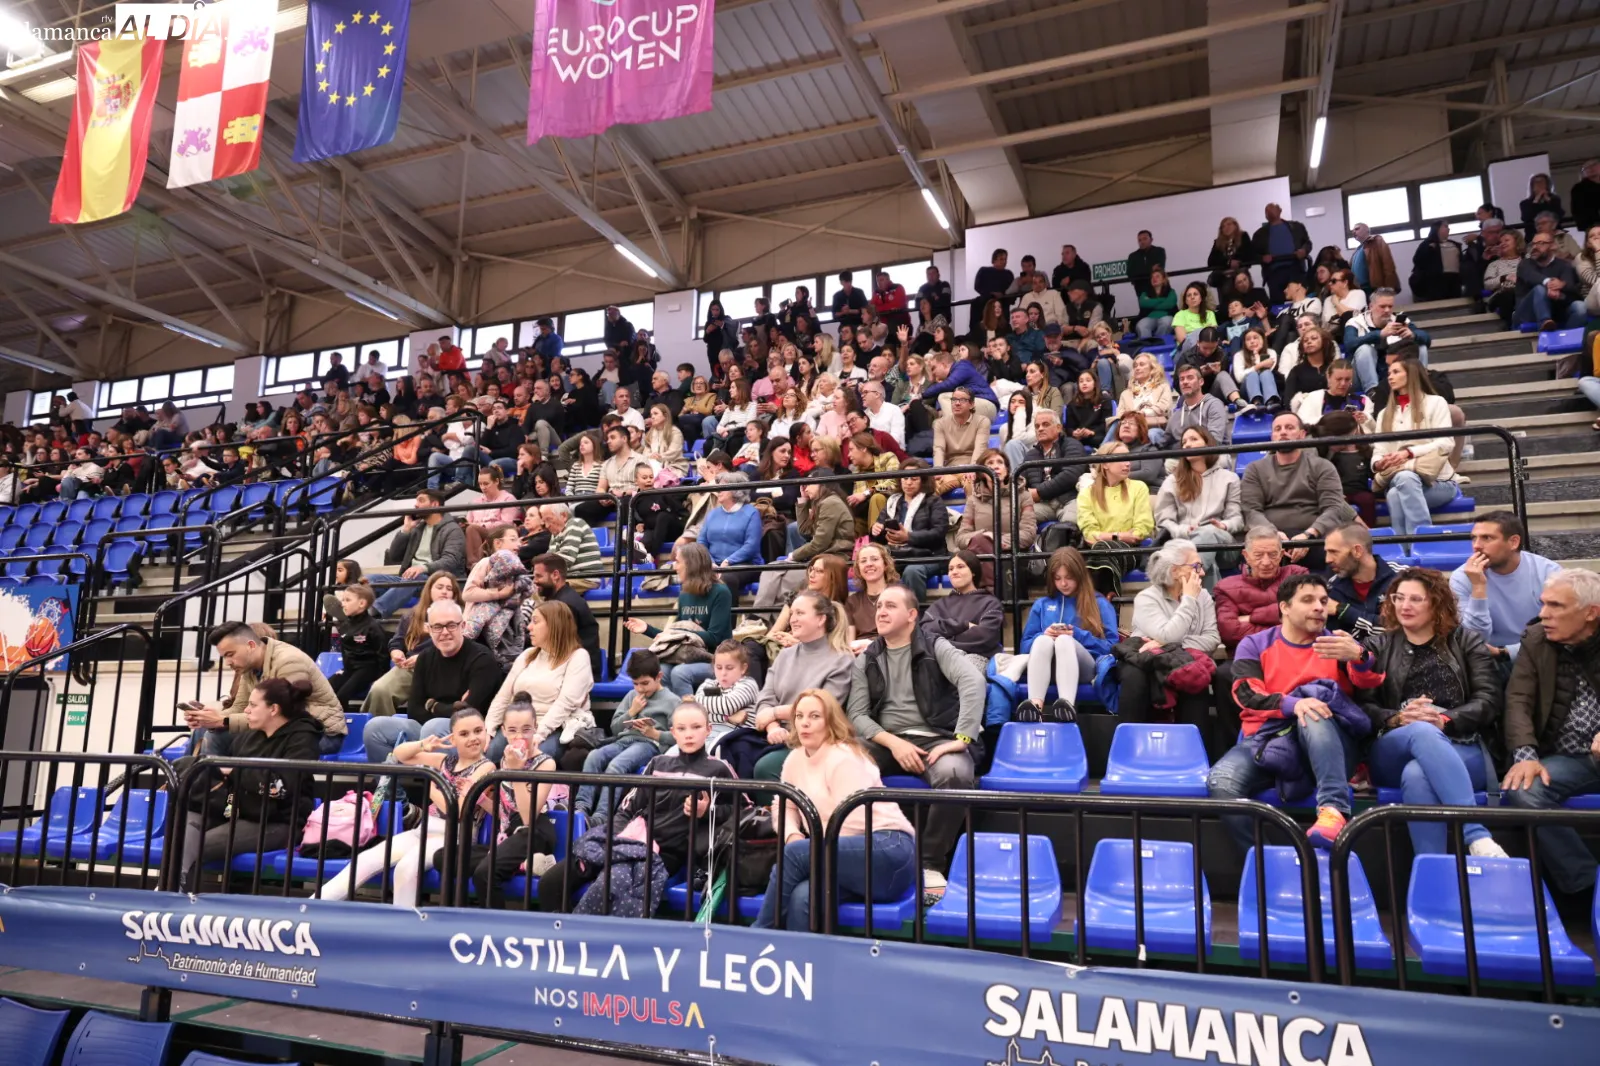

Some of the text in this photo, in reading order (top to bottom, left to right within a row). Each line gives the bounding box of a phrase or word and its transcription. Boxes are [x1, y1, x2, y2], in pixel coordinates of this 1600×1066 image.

[547, 4, 698, 56] EUROCUP
[551, 36, 681, 84] WOMEN
[1094, 261, 1127, 276] PROHIBIDO
[67, 694, 87, 704] SALIDA
[121, 910, 320, 957] SALAMANCA
[172, 953, 317, 984] Patrimonio de la Humanidad
[450, 933, 813, 1001] CASTILLA Y LEÓN
[534, 987, 578, 1009] NOS
[984, 983, 1374, 1066] SALAMANCA
